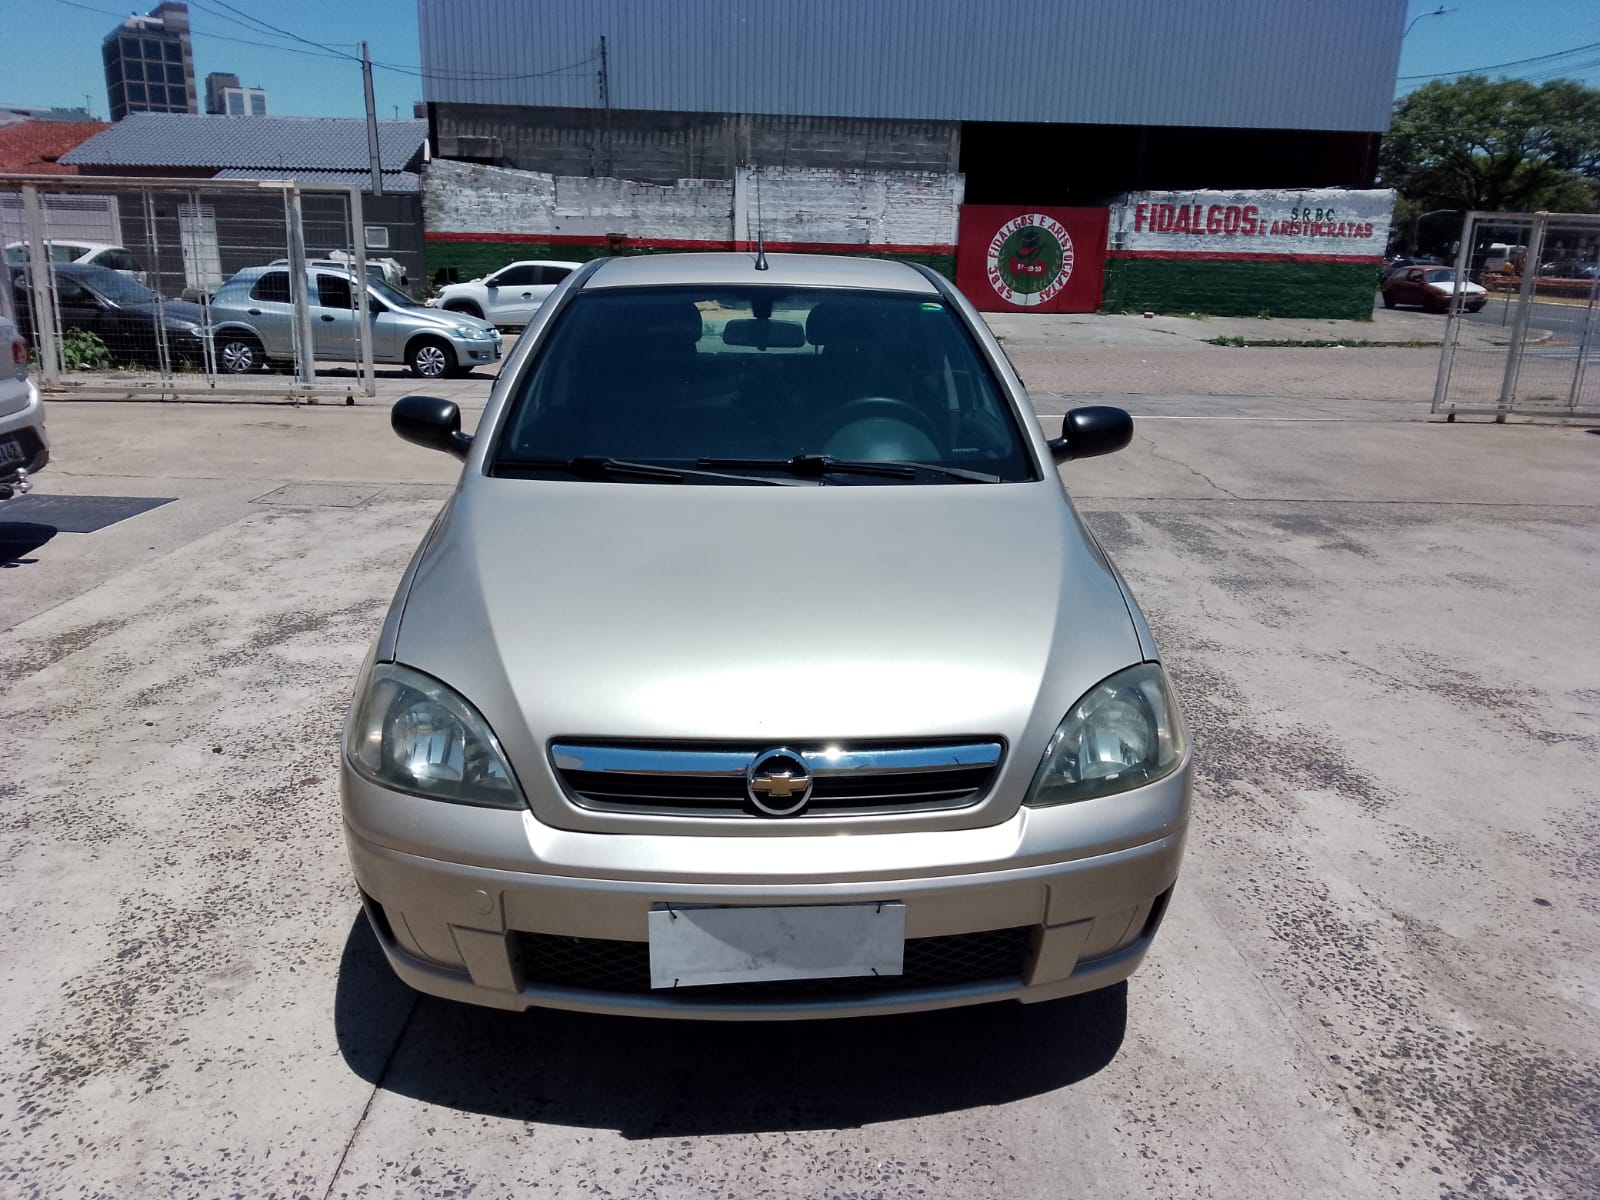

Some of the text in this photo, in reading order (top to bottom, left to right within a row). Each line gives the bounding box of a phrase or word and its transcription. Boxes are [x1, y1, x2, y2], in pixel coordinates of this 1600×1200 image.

[1134, 203, 1259, 236] FIDALGOS
[1270, 220, 1373, 238] ARISTOCRATAS
[989, 214, 1073, 302] SRBC FIDALGOS E ARISTOCRATAS
